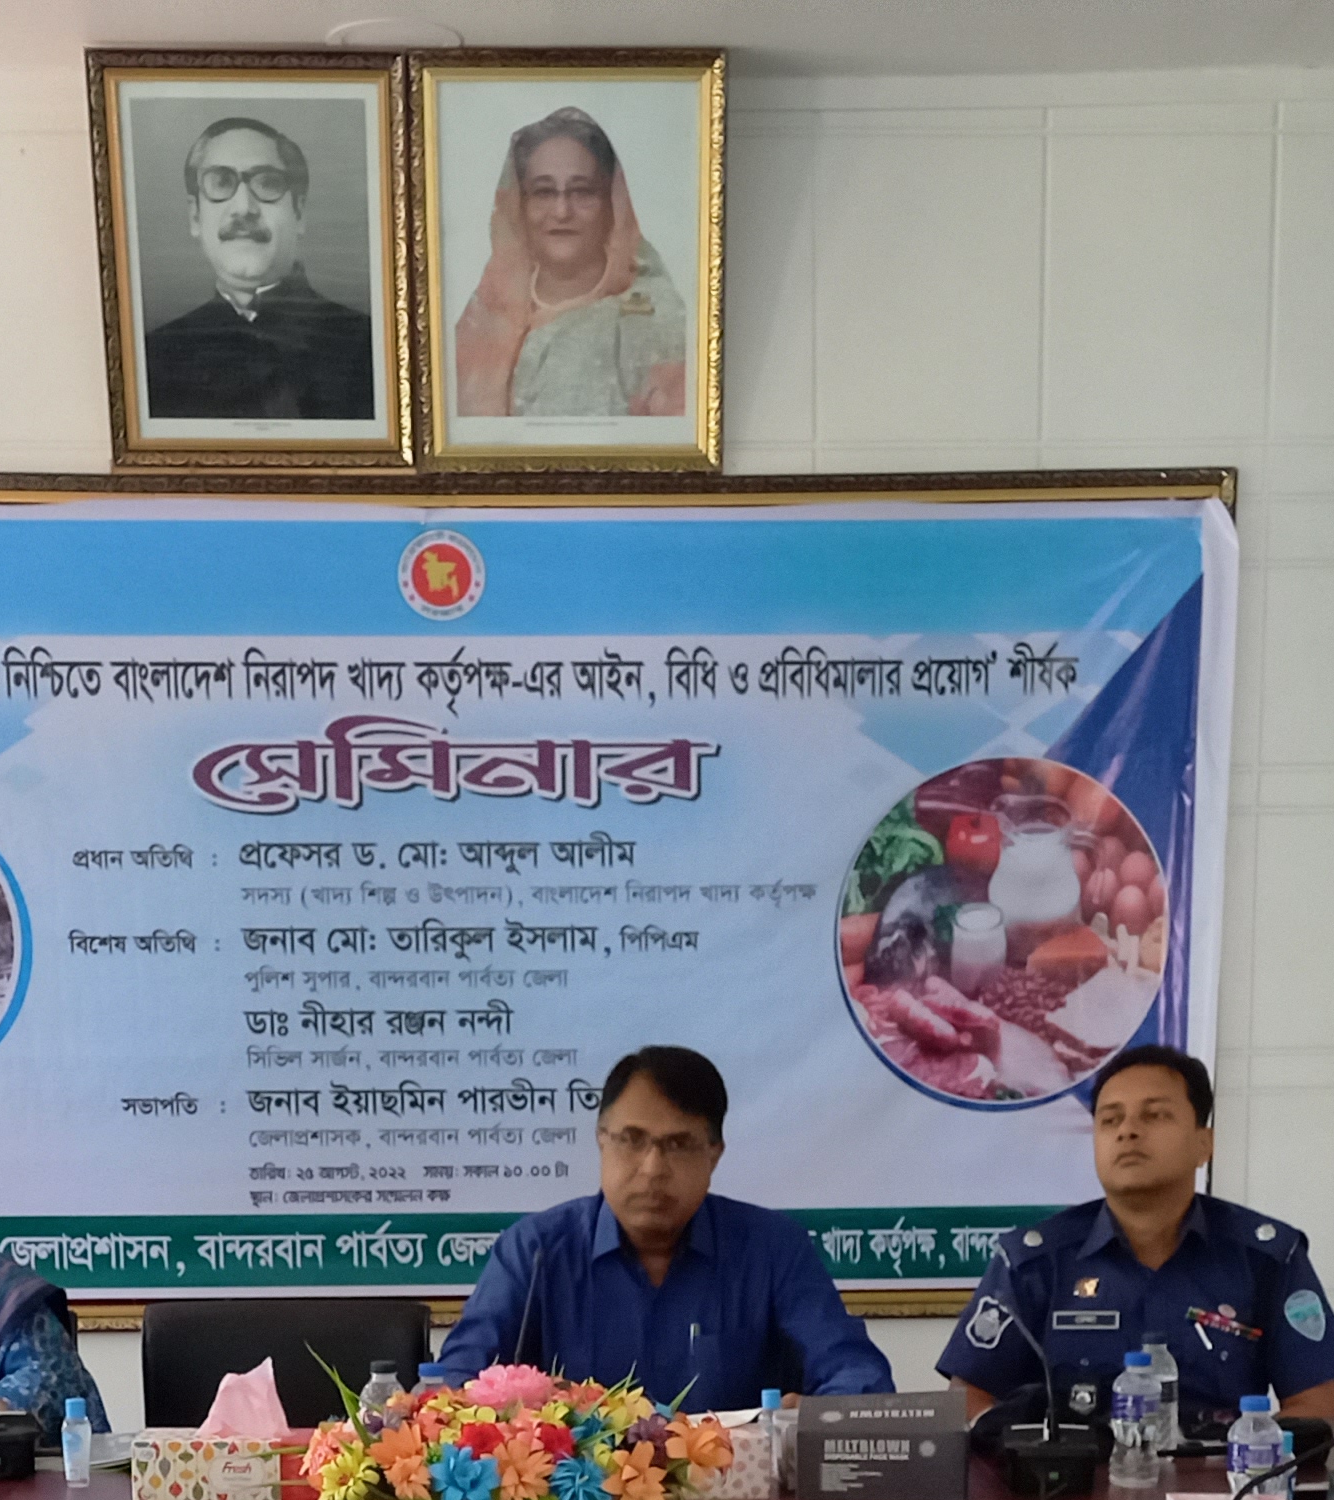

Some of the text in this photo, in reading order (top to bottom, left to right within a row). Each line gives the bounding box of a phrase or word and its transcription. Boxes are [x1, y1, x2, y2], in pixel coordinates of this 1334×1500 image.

[1, 646, 103, 699] নিশ্চিতে
[111, 658, 234, 702] বাংলাদেশ
[241, 647, 339, 701] নিরাপদ
[347, 656, 406, 701] খাদ্য
[414, 646, 564, 717] কর্তৃপক্ষ-এর
[571, 648, 656, 707] আইন,
[664, 646, 719, 698] বিধি
[728, 662, 750, 695] ও
[758, 646, 903, 698] প্রবিধিমালার
[1007, 641, 1079, 696] শীর্ষক
[192, 715, 723, 813] সেমিনার
[72, 848, 124, 870] প্রধান
[130, 844, 194, 869] অতিথি
[239, 840, 343, 870] প্রফেসর
[351, 842, 386, 869] ড.
[457, 840, 540, 875] আব্দুল
[549, 830, 636, 868] আলীম
[241, 886, 293, 906] সদস্য
[404, 888, 420, 903] ও
[530, 886, 618, 905] বাংলাদেশ
[625, 879, 692, 903] নিরাপদ
[699, 885, 741, 903] খাদ্য
[748, 879, 817, 908] কর্তৃপক্ষ
[68, 929, 127, 954] বিশেষ
[133, 929, 197, 954] অতিথি
[241, 926, 317, 954] জনাব
[386, 918, 496, 961] তারিকুল
[504, 918, 612, 957] ইসলাম,
[619, 924, 700, 952] পিপিএম
[244, 966, 295, 993] পুলিশ
[368, 970, 450, 988] বান্দরবান
[458, 965, 515, 988] পার্বত্য
[522, 969, 569, 988] জেলা
[298, 999, 375, 1037] নীহার
[384, 1009, 447, 1036] রঞ্জন
[455, 998, 515, 1035] নন্দী
[246, 1045, 303, 1068] সিভিল
[379, 1049, 460, 1068] বান্দরবান
[467, 1044, 525, 1067] পার্বত্য
[532, 1049, 578, 1067] জেলা
[121, 1092, 198, 1116] সভাপতি
[246, 1089, 322, 1117] জনাব
[330, 1080, 447, 1117] ইয়াছমিন
[457, 1078, 558, 1114] পারভীন
[378, 1129, 460, 1147] বান্দরবান
[467, 1125, 525, 1146] পার্বত্য
[532, 1127, 578, 1146] জেলা
[369, 1166, 407, 1180] ২০২২
[194, 1231, 326, 1271] বান্দরবান
[336, 1221, 427, 1268] পার্বত্য
[821, 1226, 864, 1264] খাদ্য
[823, 1439, 911, 1454] MELTBLOWN
[222, 1461, 252, 1474] Fresh
